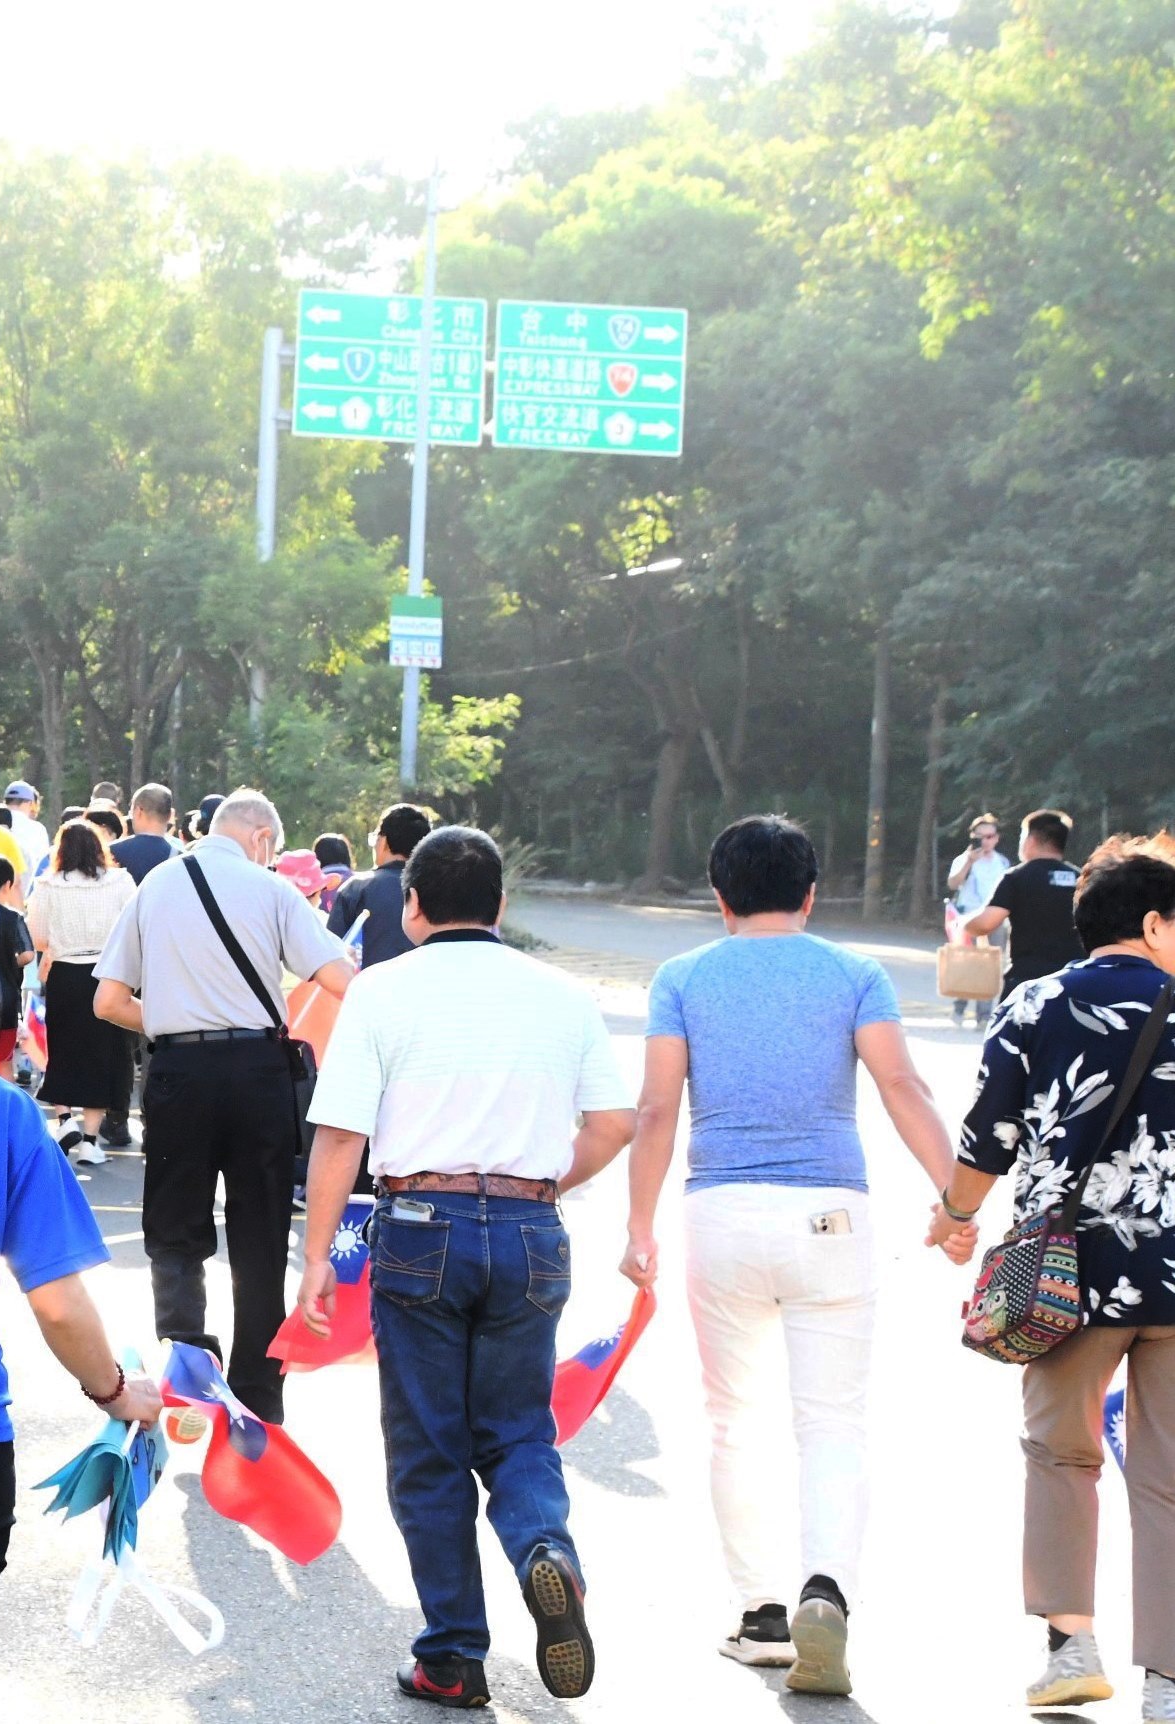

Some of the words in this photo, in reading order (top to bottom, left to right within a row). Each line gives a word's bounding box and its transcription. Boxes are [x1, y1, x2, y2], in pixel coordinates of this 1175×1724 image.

[520, 307, 588, 333] 台中
[451, 328, 478, 345] City
[520, 331, 587, 351] Taichung
[503, 380, 600, 396] EXPRESSWAY
[502, 401, 600, 430] 快官交流道
[382, 421, 464, 438] FREWAY
[507, 428, 592, 444] FREEWAY
